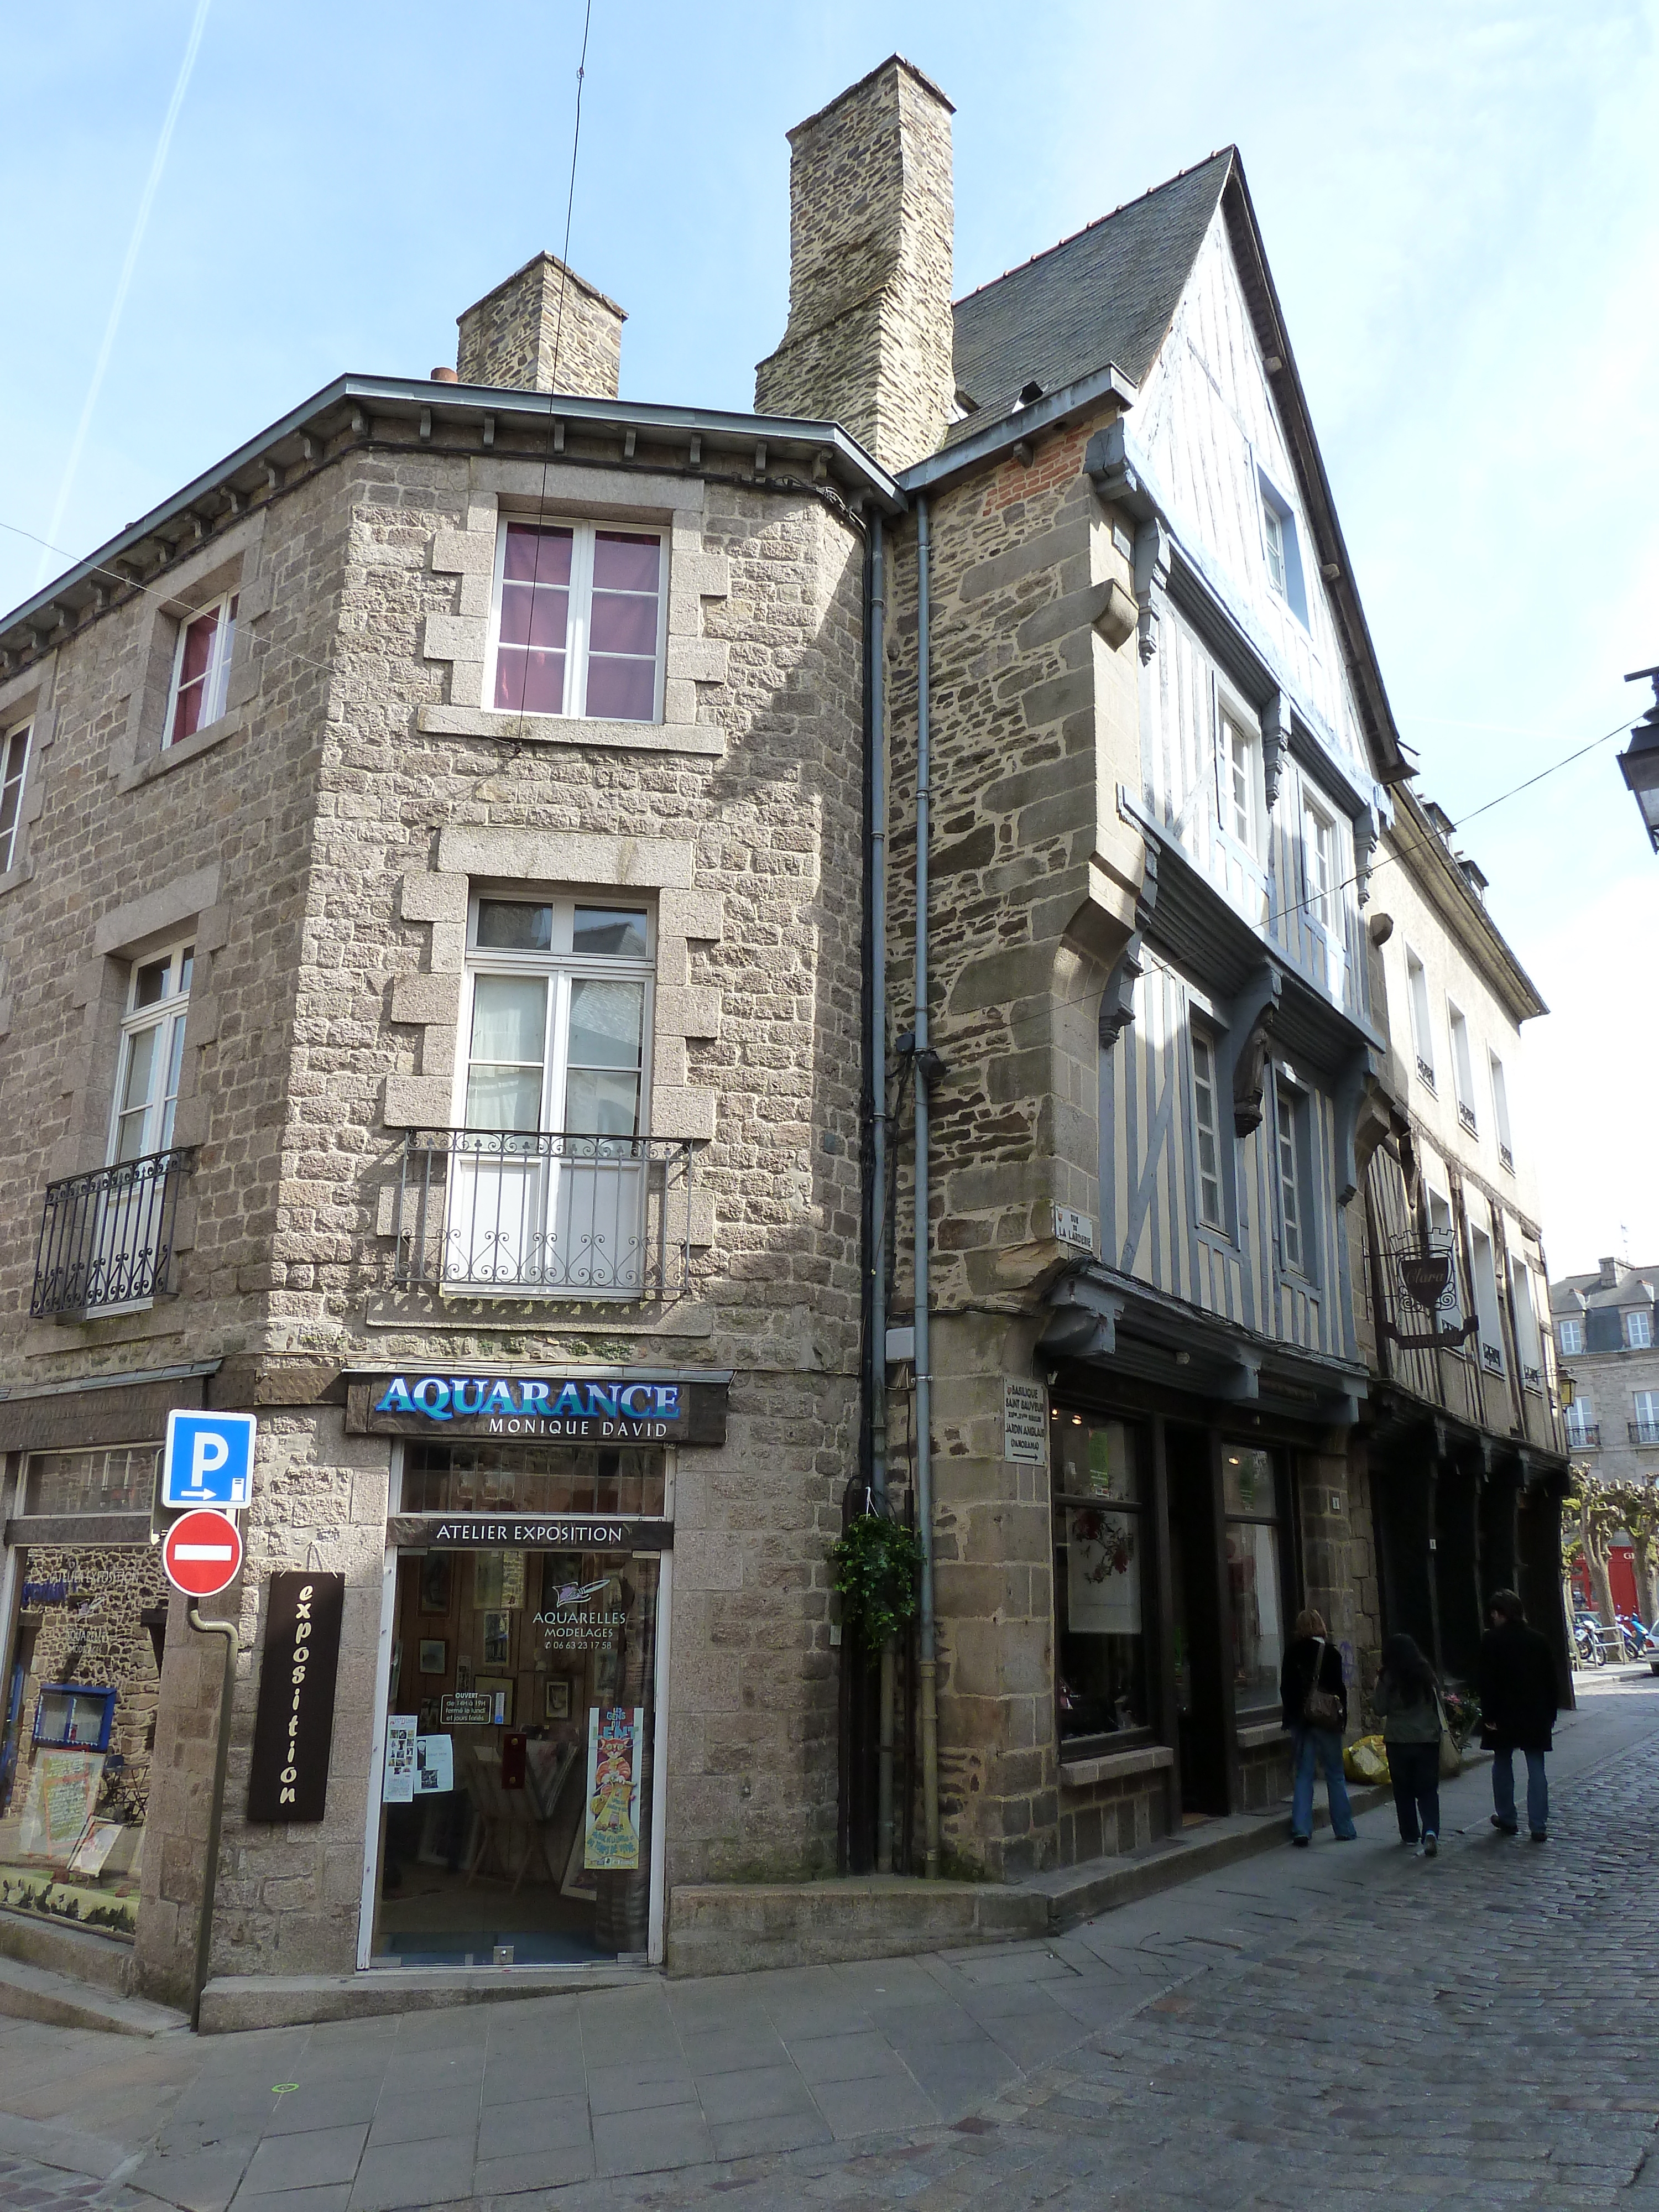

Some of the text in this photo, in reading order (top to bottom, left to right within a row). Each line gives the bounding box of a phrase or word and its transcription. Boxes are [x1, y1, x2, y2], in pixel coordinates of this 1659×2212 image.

[1059, 1226, 1066, 1237] LA
[376, 1377, 680, 1420] AQUARANCE
[1012, 1385, 1038, 1399] BASILIQUE
[1006, 1397, 1019, 1409] SAINT
[489, 1418, 667, 1437] MONIQUE DAVID
[1006, 1423, 1022, 1435] JARDIN
[191, 1432, 228, 1487] P
[436, 1525, 622, 1541] ATELIER EXPOSITION
[533, 1612, 626, 1625] AQUARELLES
[544, 1628, 613, 1637] MODELAGES
[279, 1585, 313, 1804] exposition
[607, 1712, 626, 1720] GENS
[592, 1726, 639, 1740] LENT
